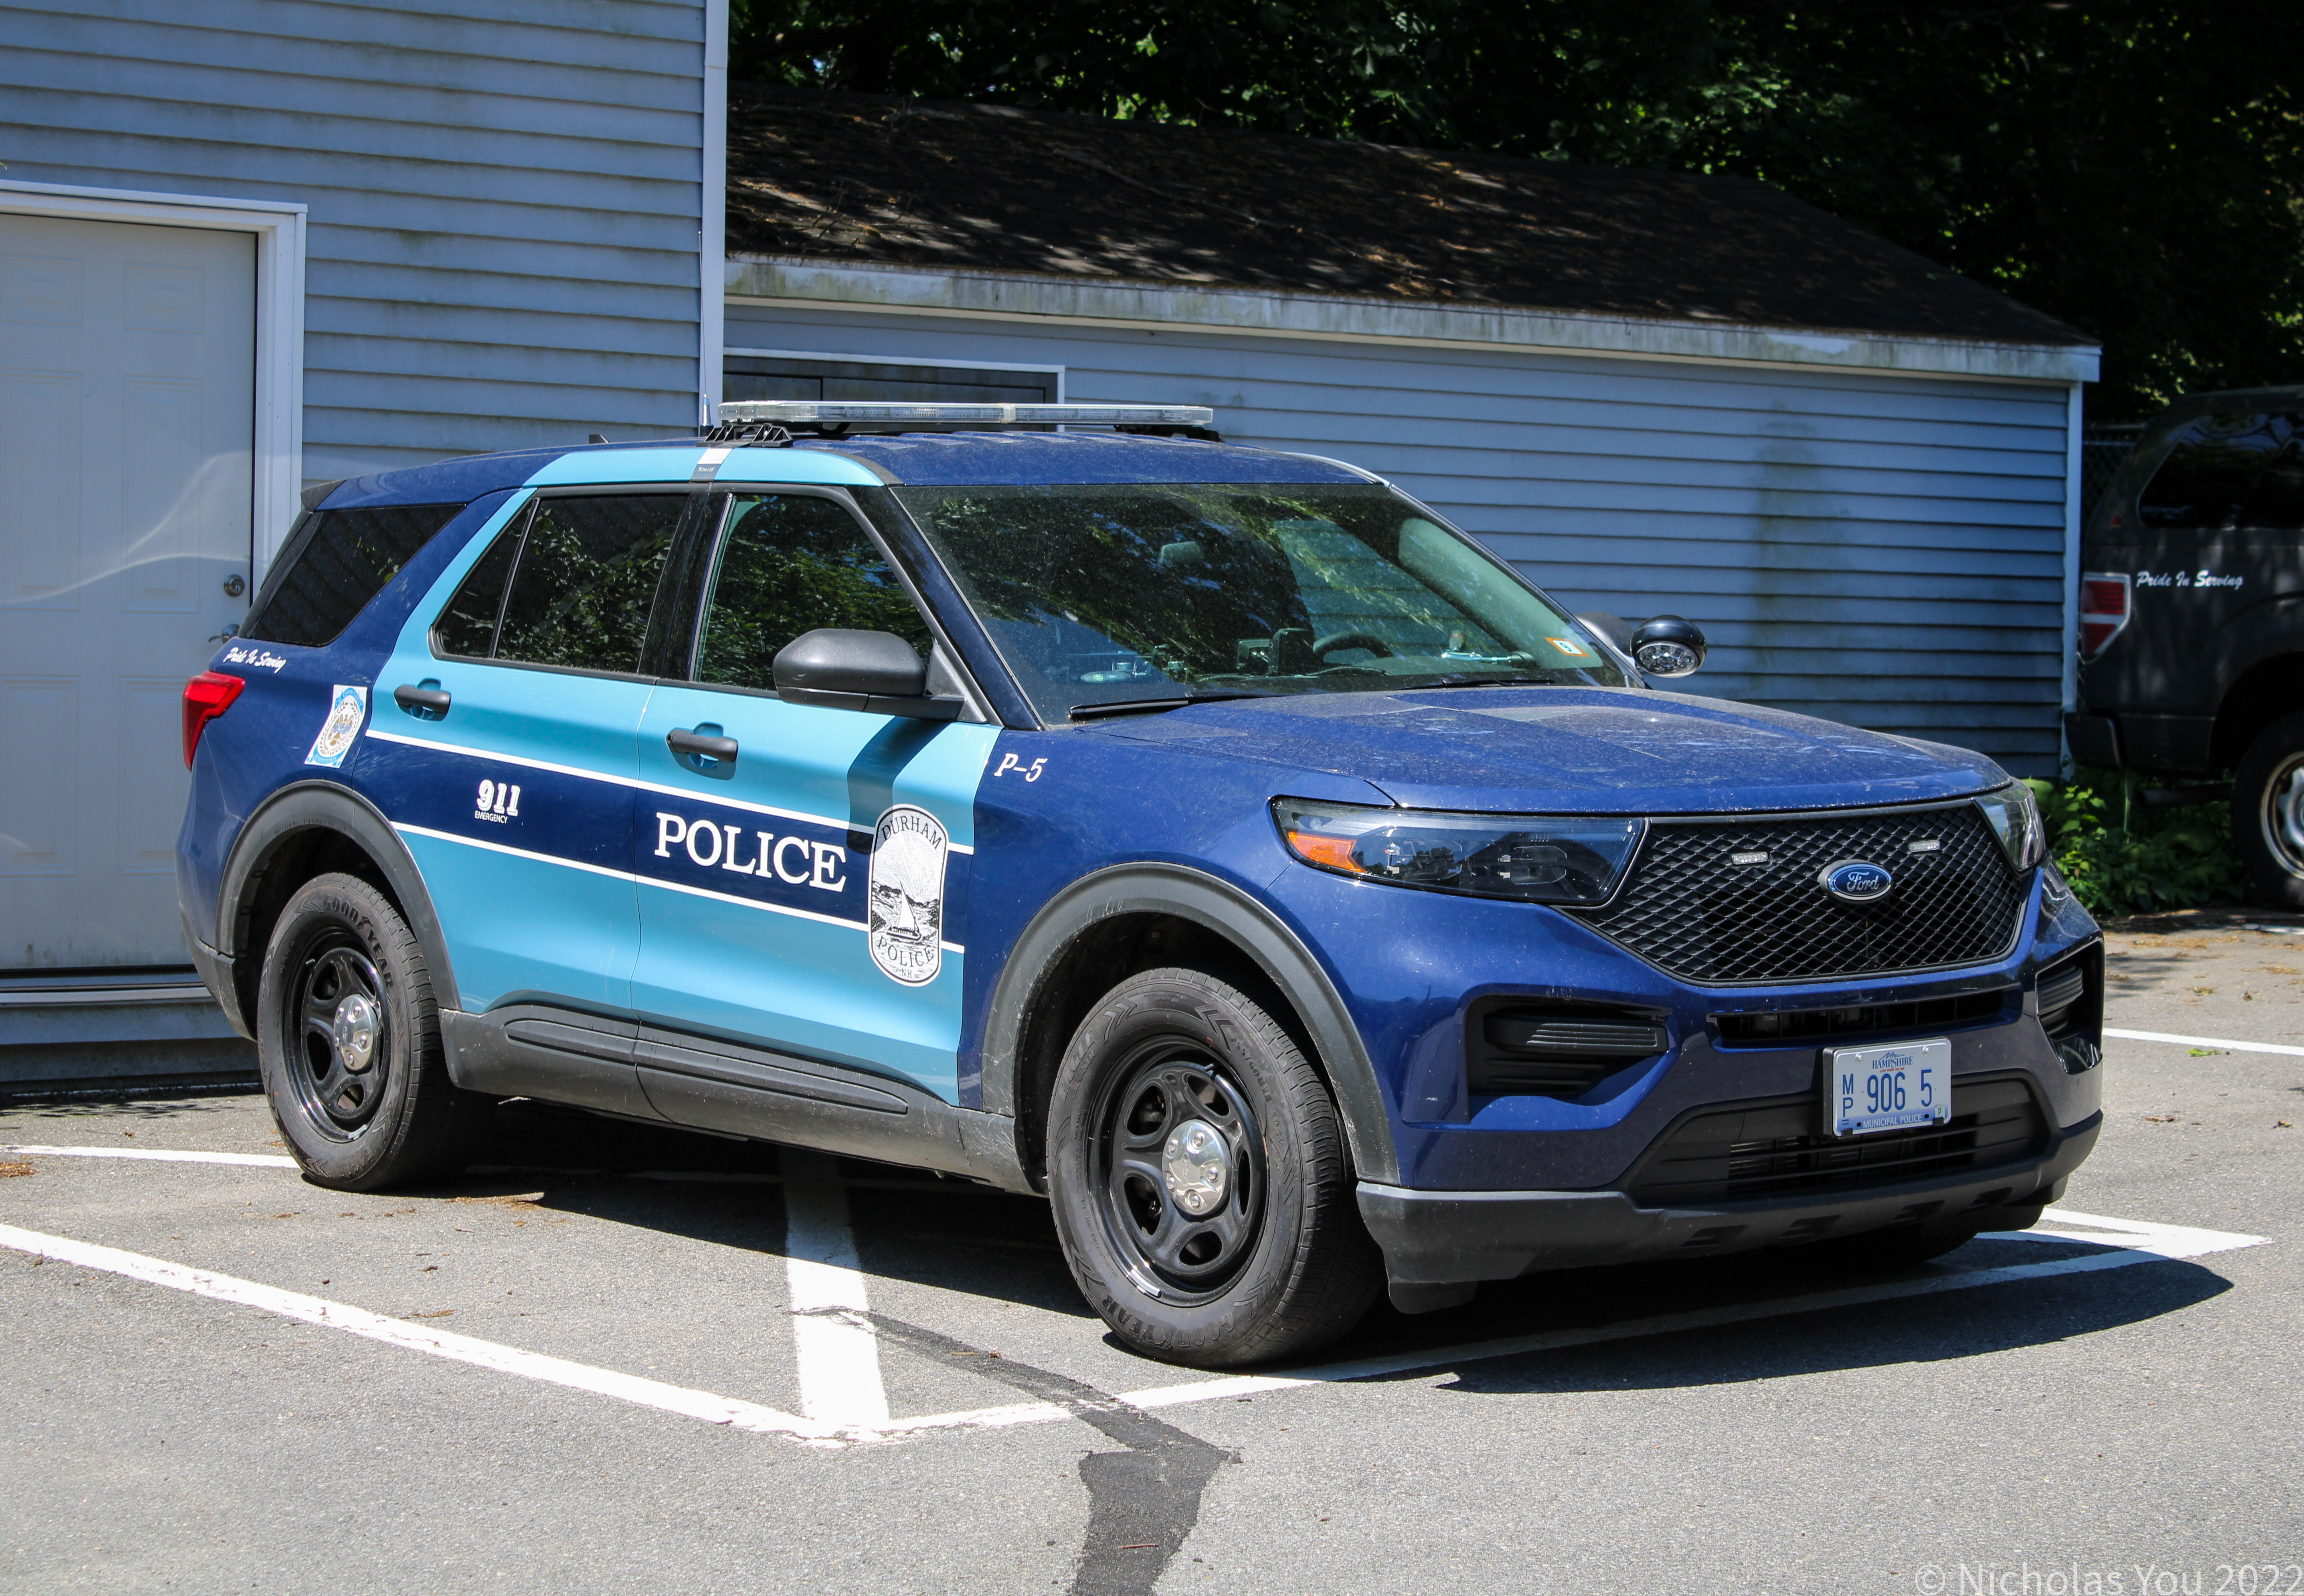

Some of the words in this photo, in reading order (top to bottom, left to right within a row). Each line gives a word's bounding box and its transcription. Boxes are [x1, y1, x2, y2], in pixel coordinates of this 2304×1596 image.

[2136, 570, 2172, 587] Pride
[2175, 571, 2190, 587] In
[2194, 569, 2244, 591] Serving
[223, 646, 248, 663] Pride
[245, 649, 259, 665] In
[253, 652, 287, 674] Serving
[994, 753, 1048, 783] P-5
[476, 779, 521, 817] 911
[475, 810, 508, 824] EMERGENCY
[881, 815, 942, 851] DURHAM
[654, 811, 847, 893] POLICE
[1847, 871, 1879, 892] Ford
[878, 934, 934, 967] POLICE
[1059, 1027, 1094, 1103] EAGLE
[1872, 1056, 1913, 1070] HAMPSHIRE
[1879, 1051, 1905, 1060] New
[1867, 1072, 1906, 1114] 906
[1920, 1069, 1932, 1108] 5
[1863, 1116, 1898, 1129] MUNICIPAL
[1900, 1113, 1922, 1124] POLICE
